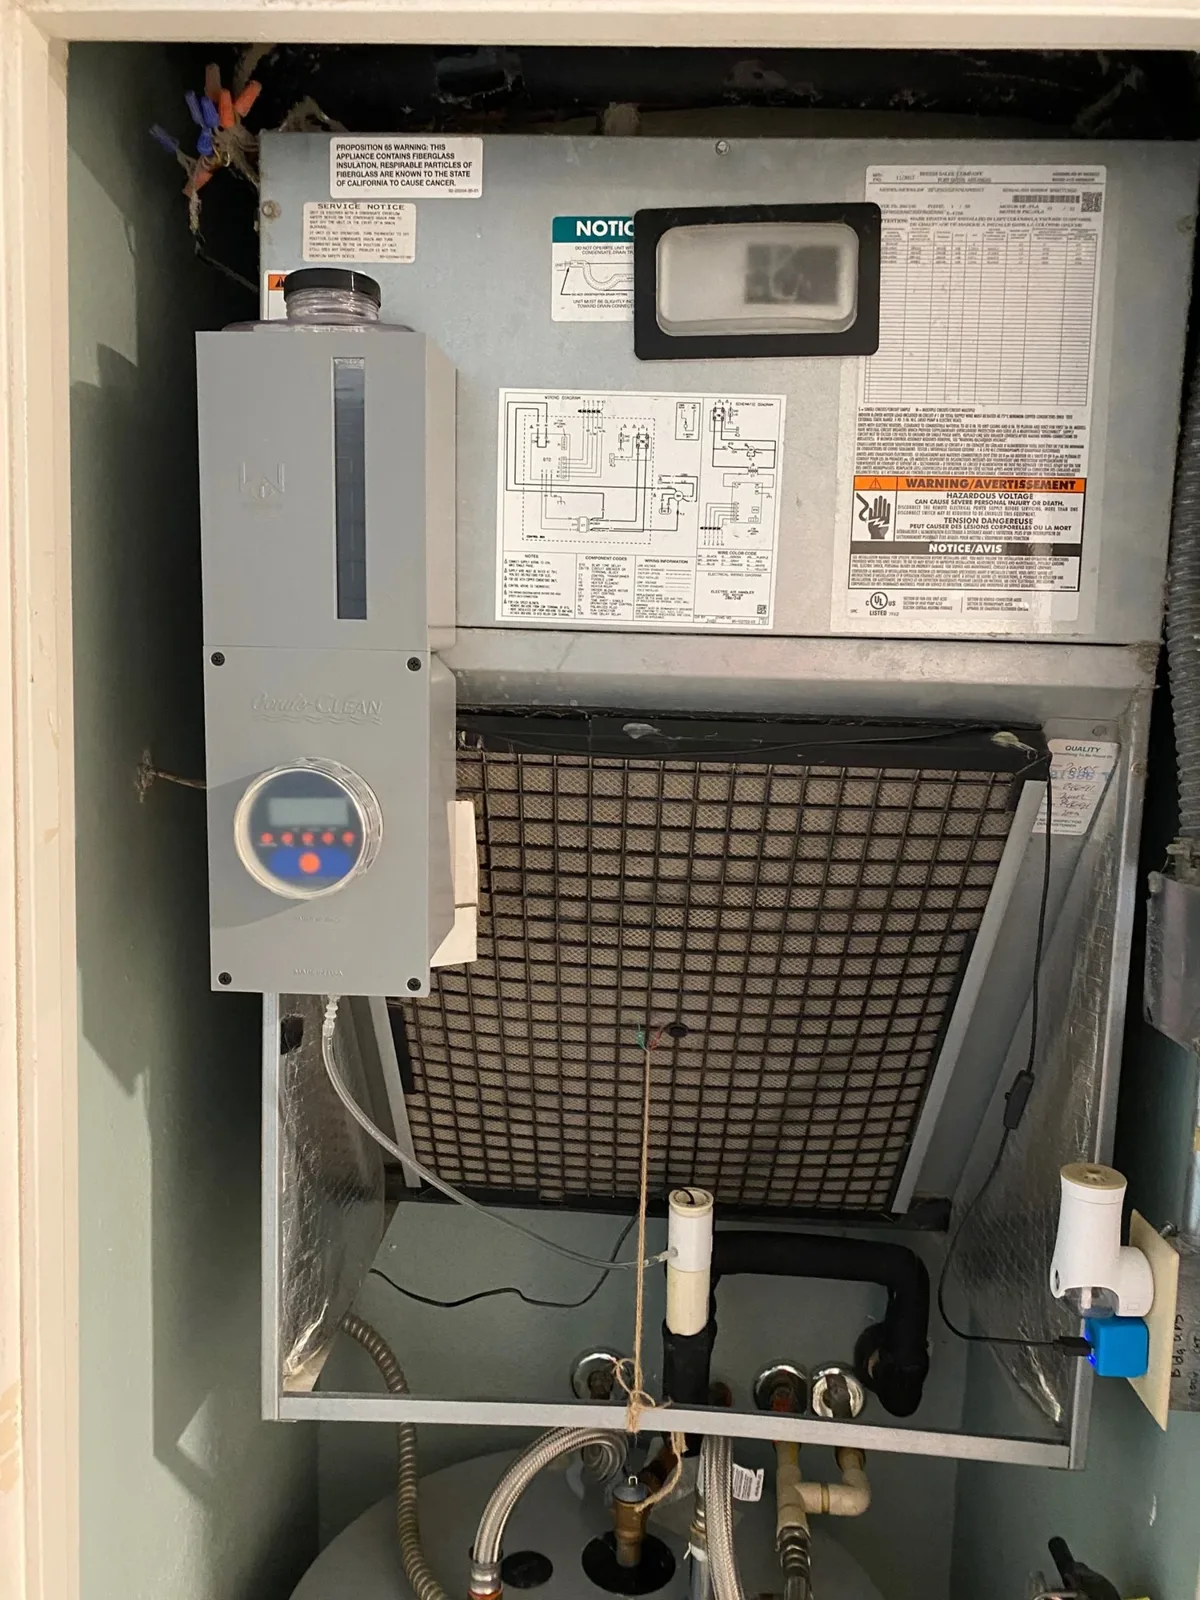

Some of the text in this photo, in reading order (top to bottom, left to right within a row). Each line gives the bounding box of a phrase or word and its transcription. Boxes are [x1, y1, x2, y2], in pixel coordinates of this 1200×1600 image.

[336, 152, 455, 160] APPLIANCE CONTAINS FIBERGLASS
[336, 170, 471, 178] FIBERGLASS ARE KNOWN TO THE STATE
[576, 220, 634, 237] NOTIC
[906, 479, 1076, 490] WARNING/AVERTISSEMENT
[946, 492, 1034, 500] HAZARDOUS VOLTAGE
[929, 544, 1002, 554] NOTICE/AVIS
